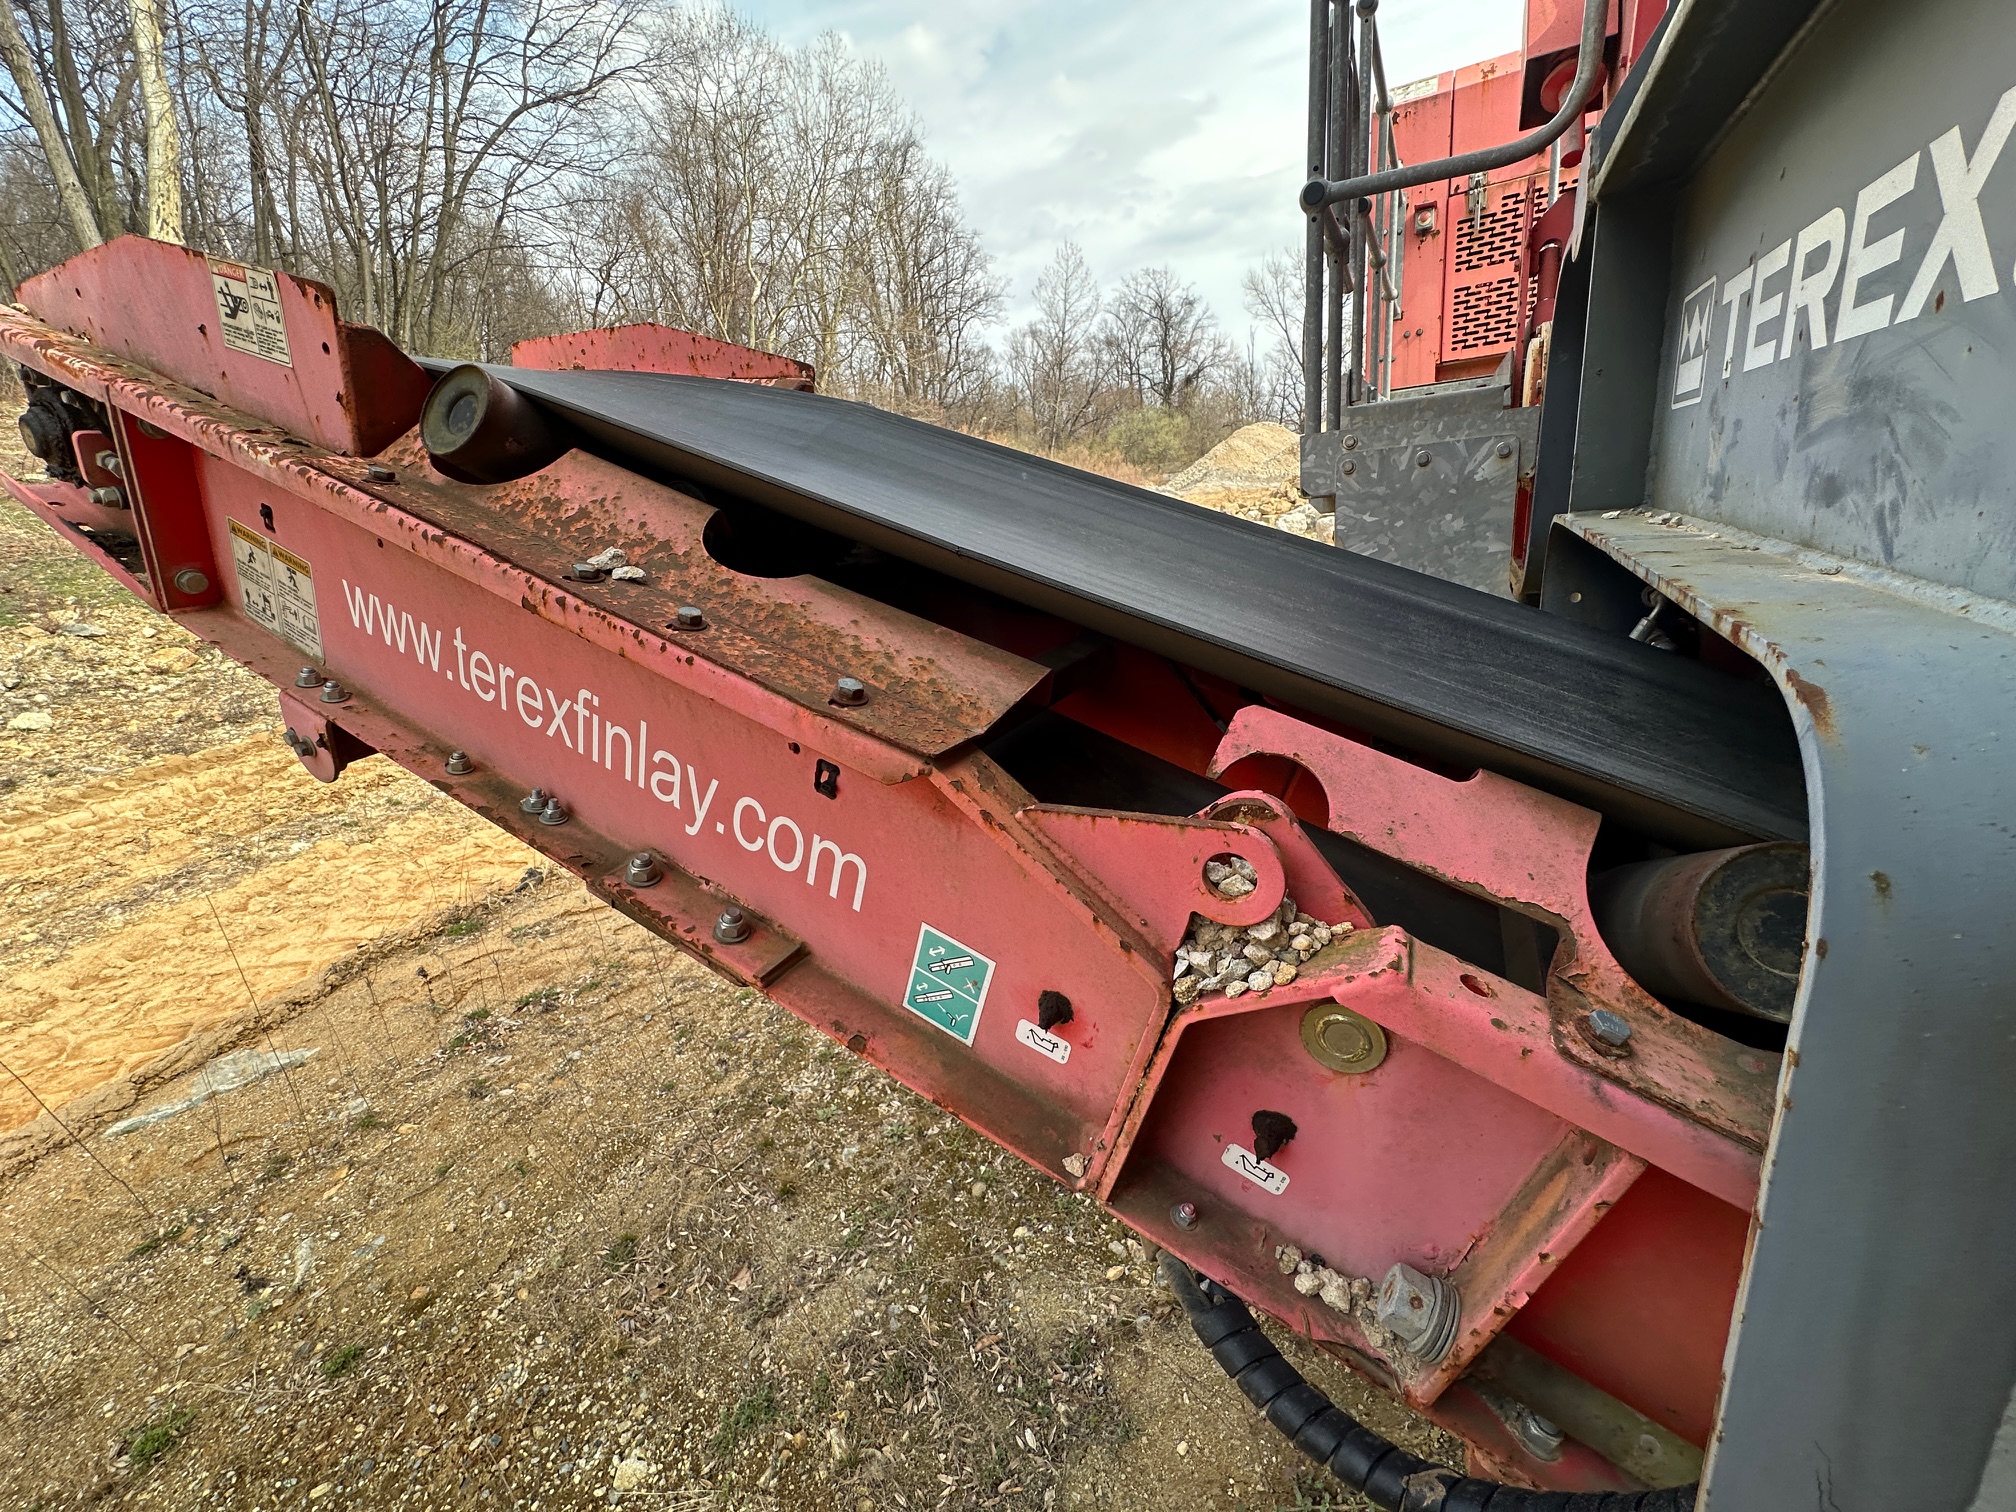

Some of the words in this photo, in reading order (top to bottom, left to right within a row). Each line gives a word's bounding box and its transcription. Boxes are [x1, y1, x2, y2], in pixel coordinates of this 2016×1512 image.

[1722, 84, 2016, 380] TEREX
[217, 265, 244, 279] DANGER
[236, 525, 267, 548] WARNING
[277, 550, 309, 574] WARNING
[342, 578, 868, 913] www.terexfinlay.com
